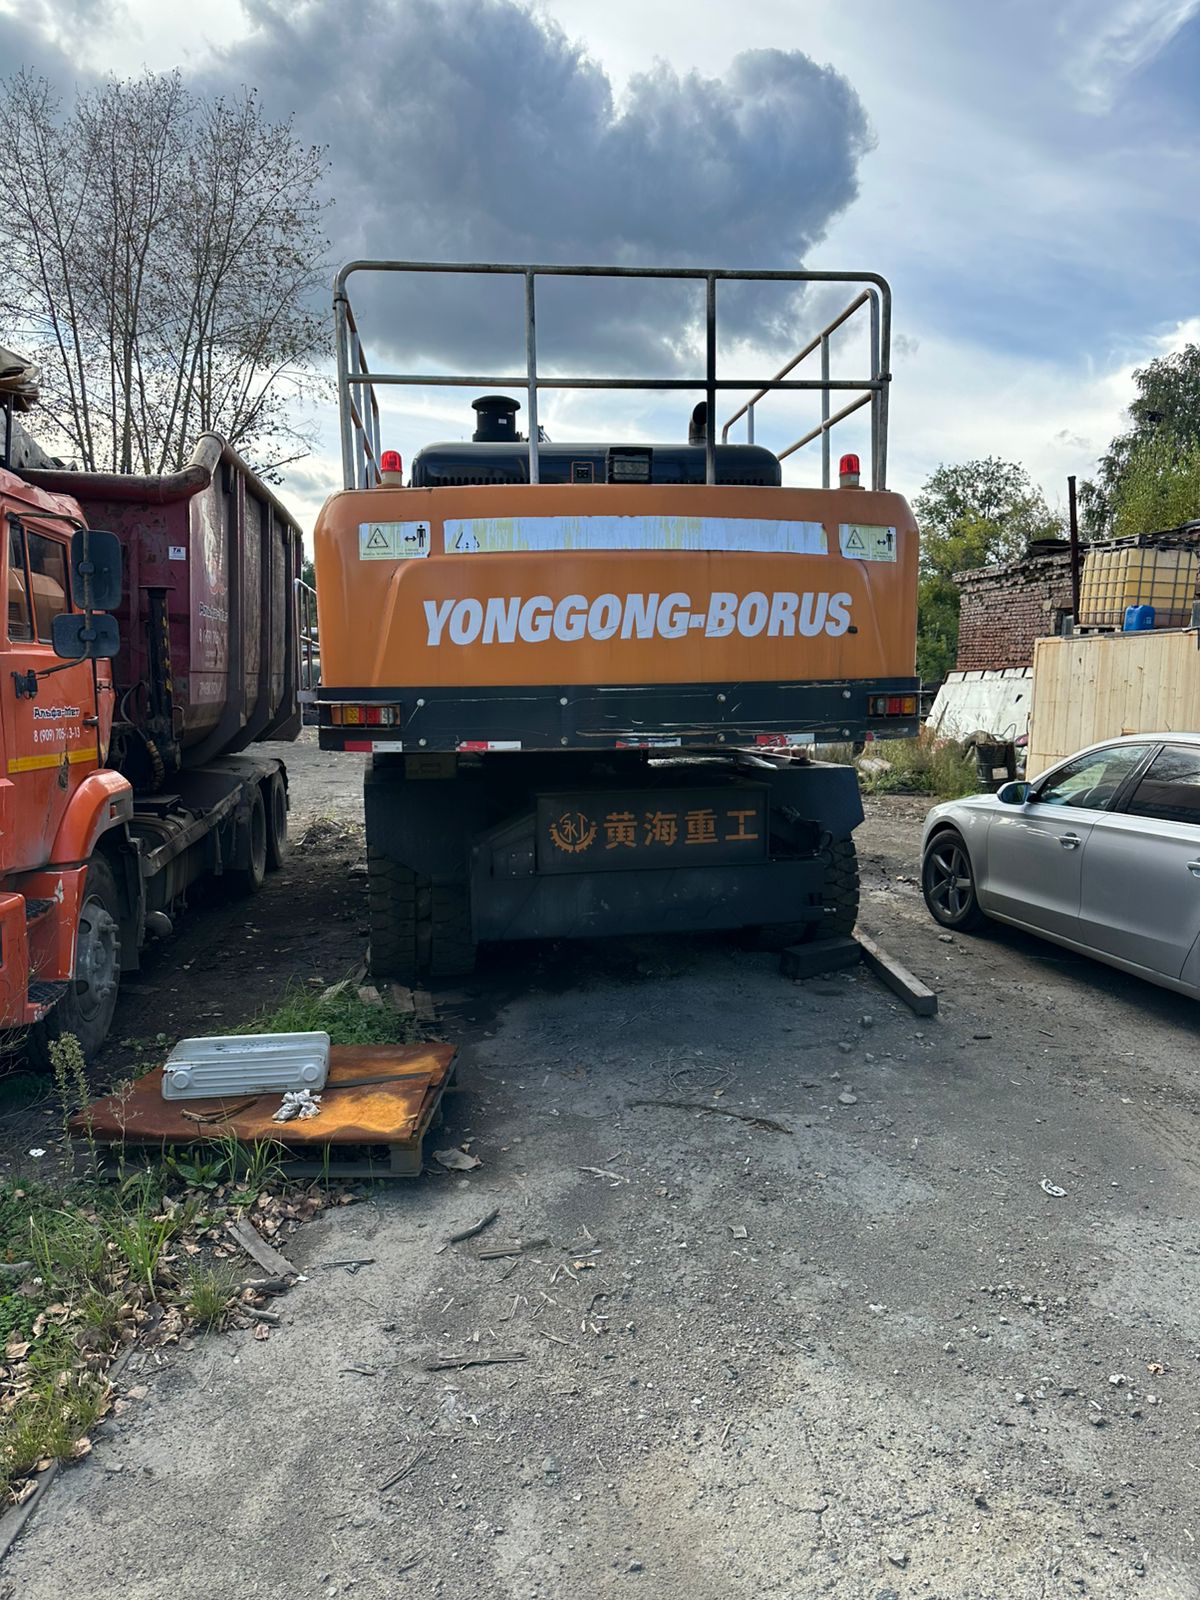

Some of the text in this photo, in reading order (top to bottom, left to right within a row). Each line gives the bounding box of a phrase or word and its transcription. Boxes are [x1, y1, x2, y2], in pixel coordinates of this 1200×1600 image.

[423, 592, 852, 646] YONGGONG-BORUS
[33, 730, 38, 742] 8
[39, 729, 55, 743] (909)
[603, 808, 759, 850] 黄海重工
